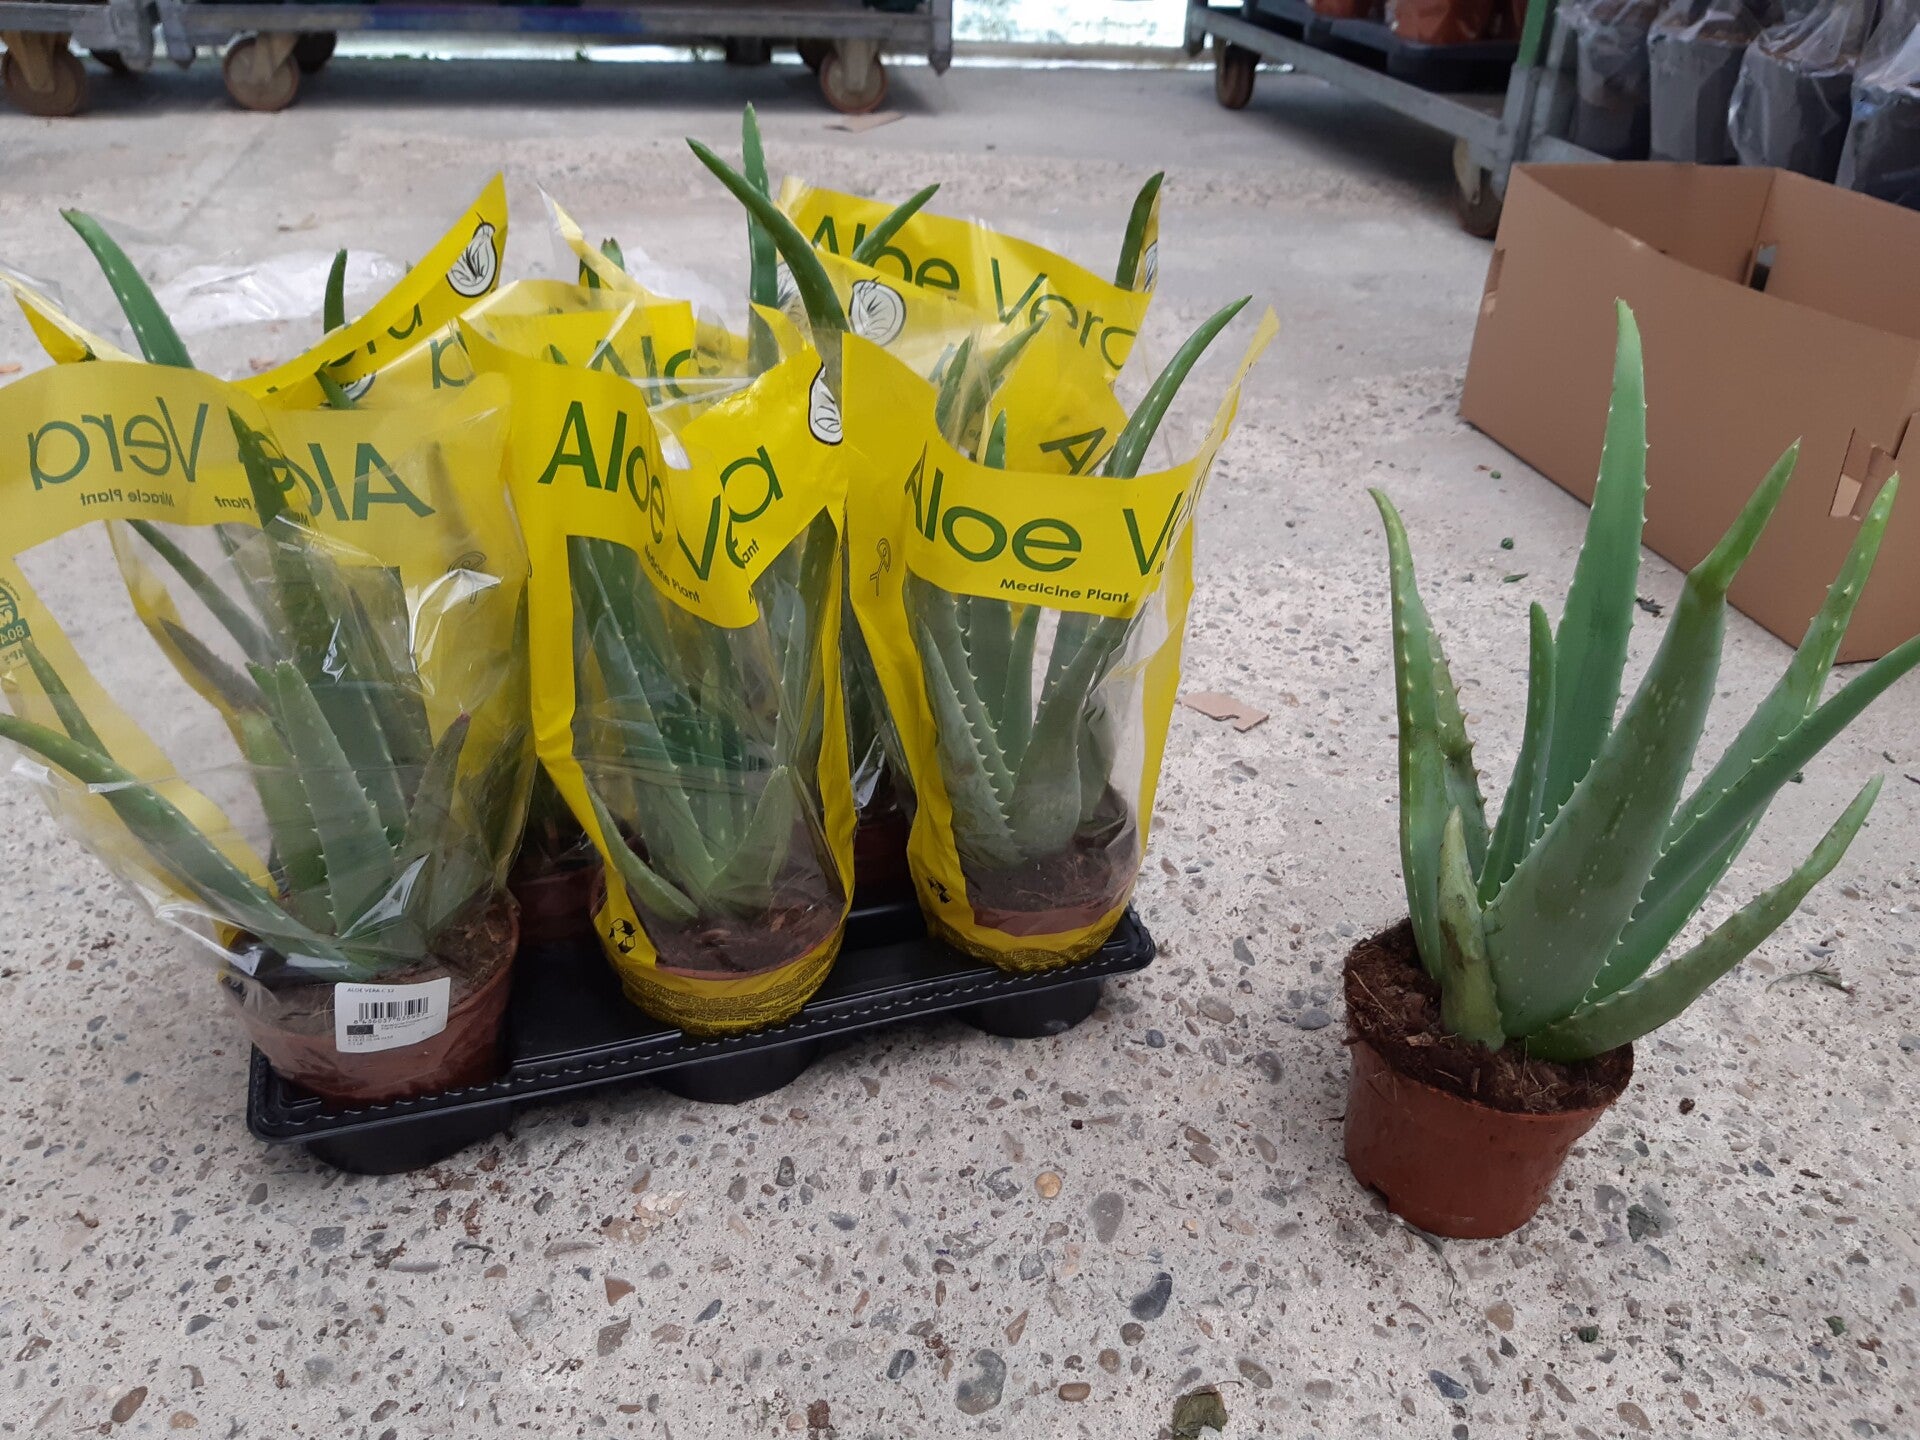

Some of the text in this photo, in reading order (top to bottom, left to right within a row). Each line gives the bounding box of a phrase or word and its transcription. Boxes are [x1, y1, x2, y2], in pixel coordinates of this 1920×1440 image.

[904, 440, 1083, 572] Aloe
[741, 537, 760, 564] ant
[1000, 578, 1130, 604] Medicine Plant
